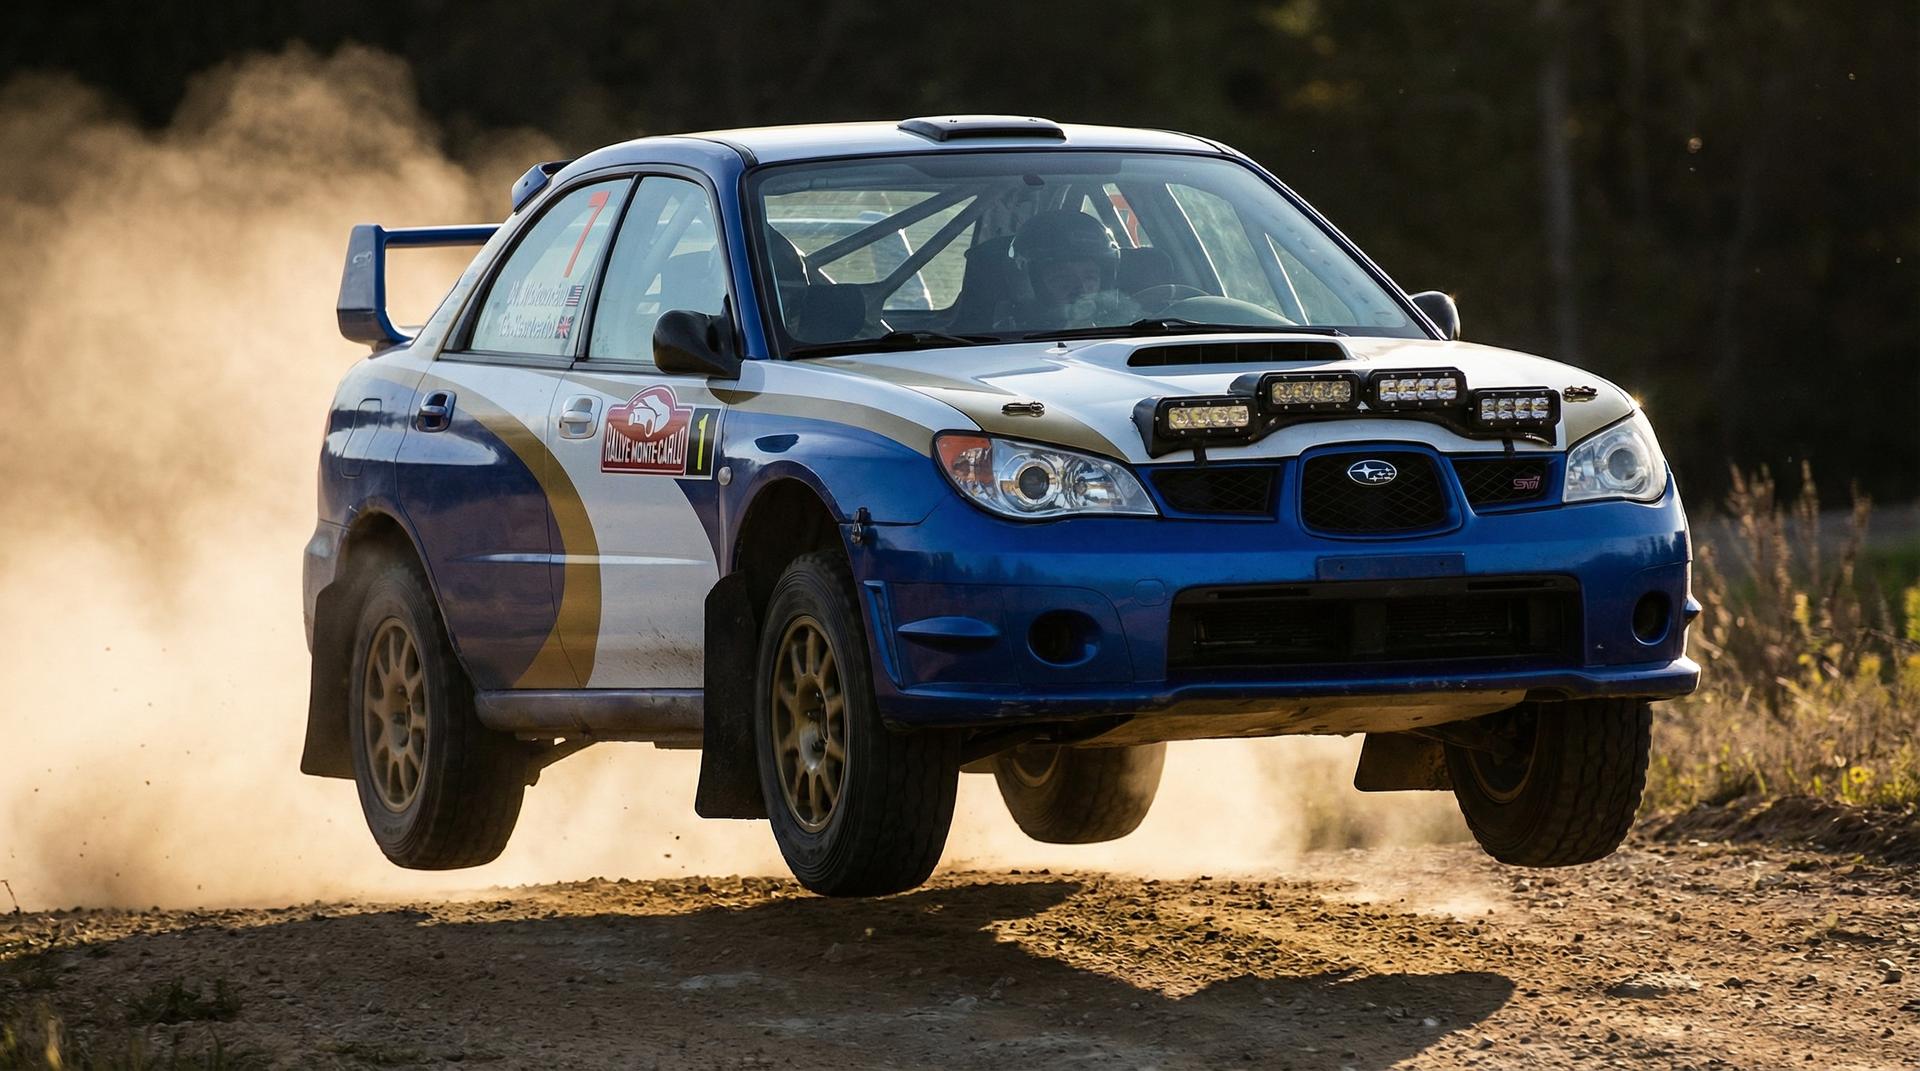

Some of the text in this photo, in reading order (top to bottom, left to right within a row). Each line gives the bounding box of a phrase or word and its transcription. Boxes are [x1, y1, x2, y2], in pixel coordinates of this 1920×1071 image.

[564, 191, 610, 277] 7
[605, 422, 631, 462] RALLYE
[697, 413, 709, 470] 1
